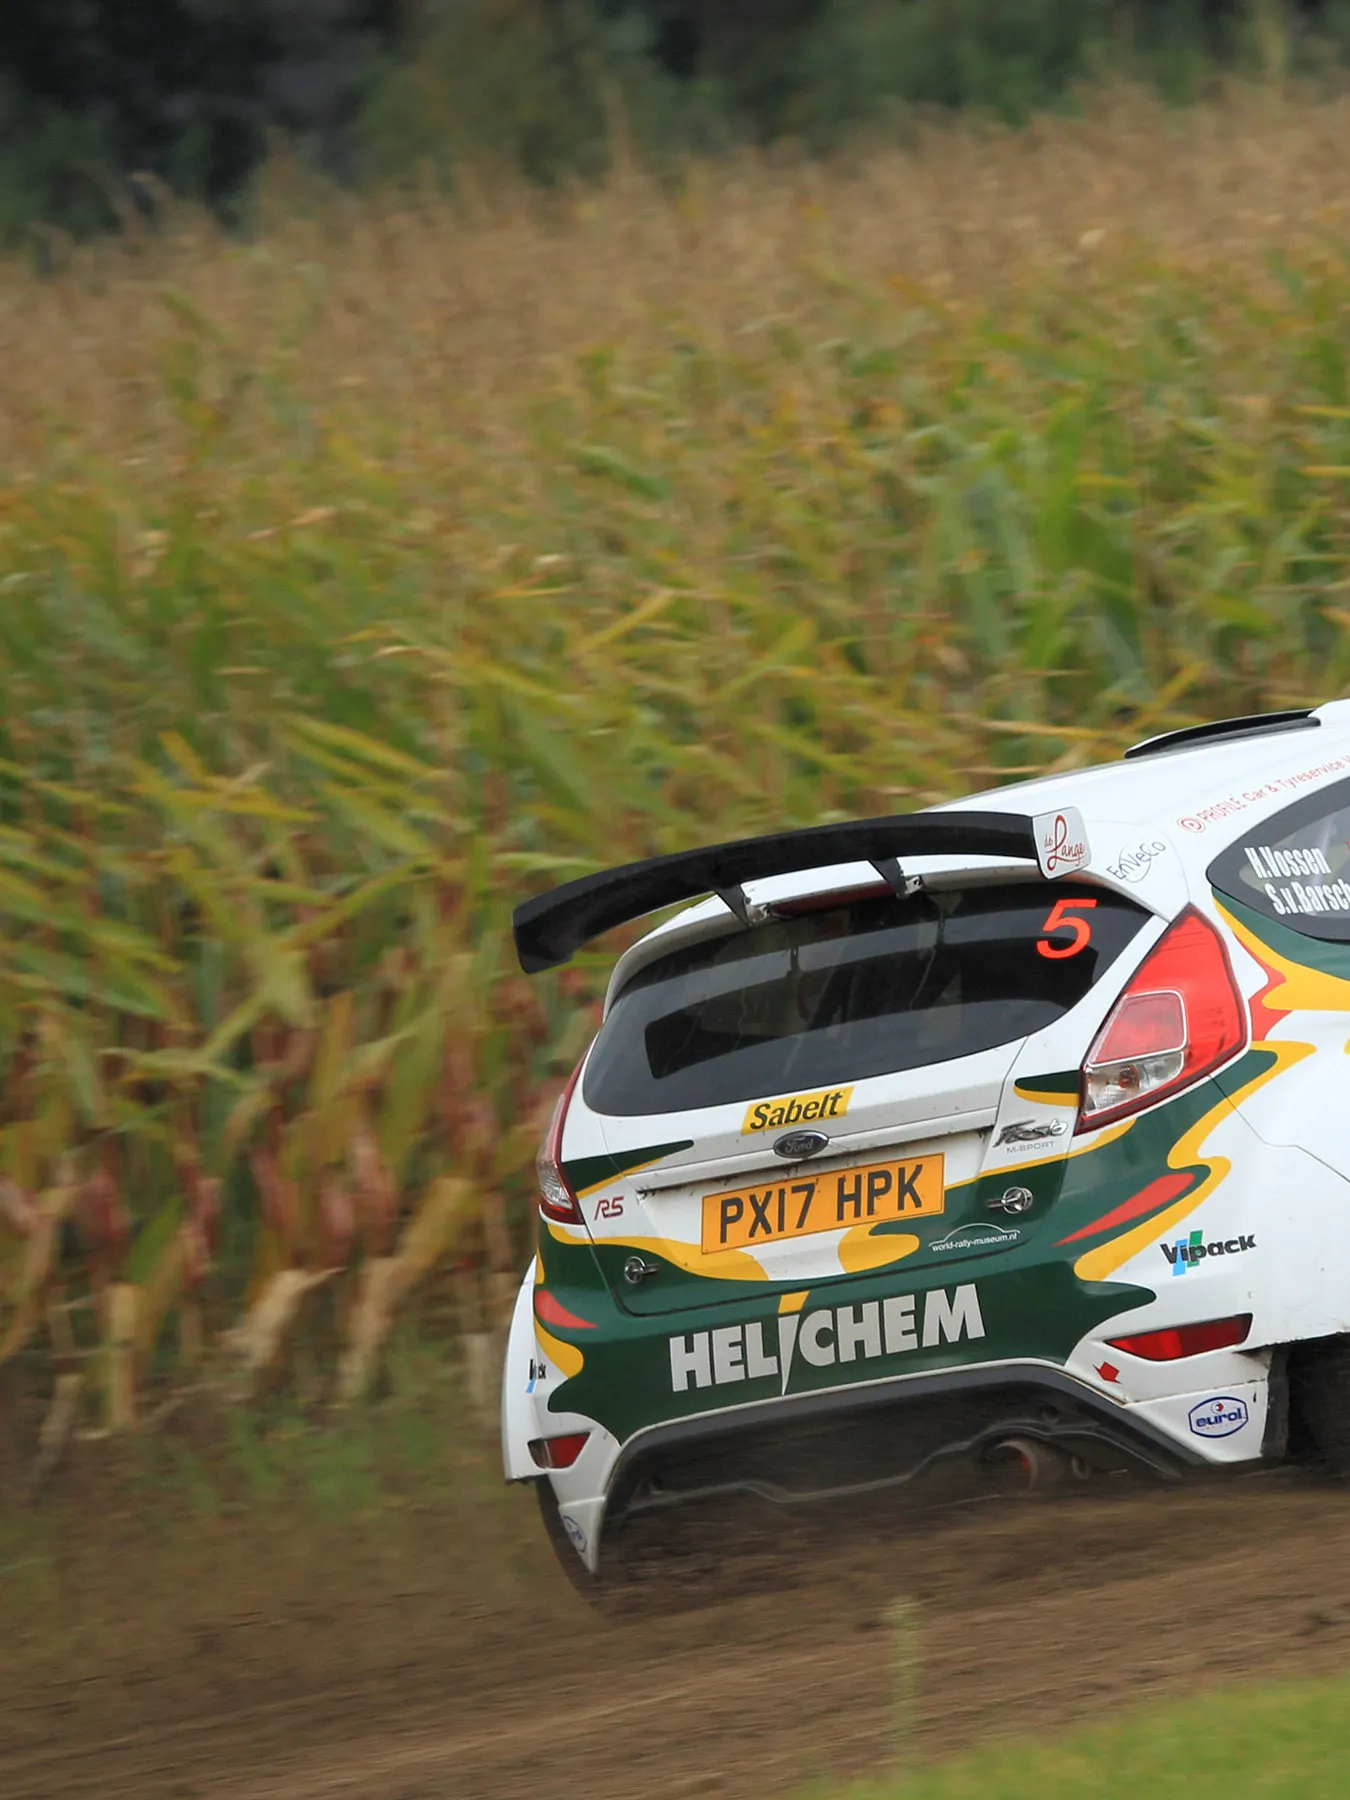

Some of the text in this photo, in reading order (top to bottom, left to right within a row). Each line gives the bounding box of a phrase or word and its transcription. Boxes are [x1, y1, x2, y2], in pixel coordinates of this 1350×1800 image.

[1035, 898, 1098, 959] 5
[749, 1090, 843, 1130] Sabelt
[784, 1137, 814, 1154] Ford
[719, 1164, 923, 1243] PX17 HPK
[932, 1232, 1017, 1252] world-rally-museum.nl
[1160, 1233, 1257, 1265] Vipack
[1196, 1407, 1242, 1427] eurol
